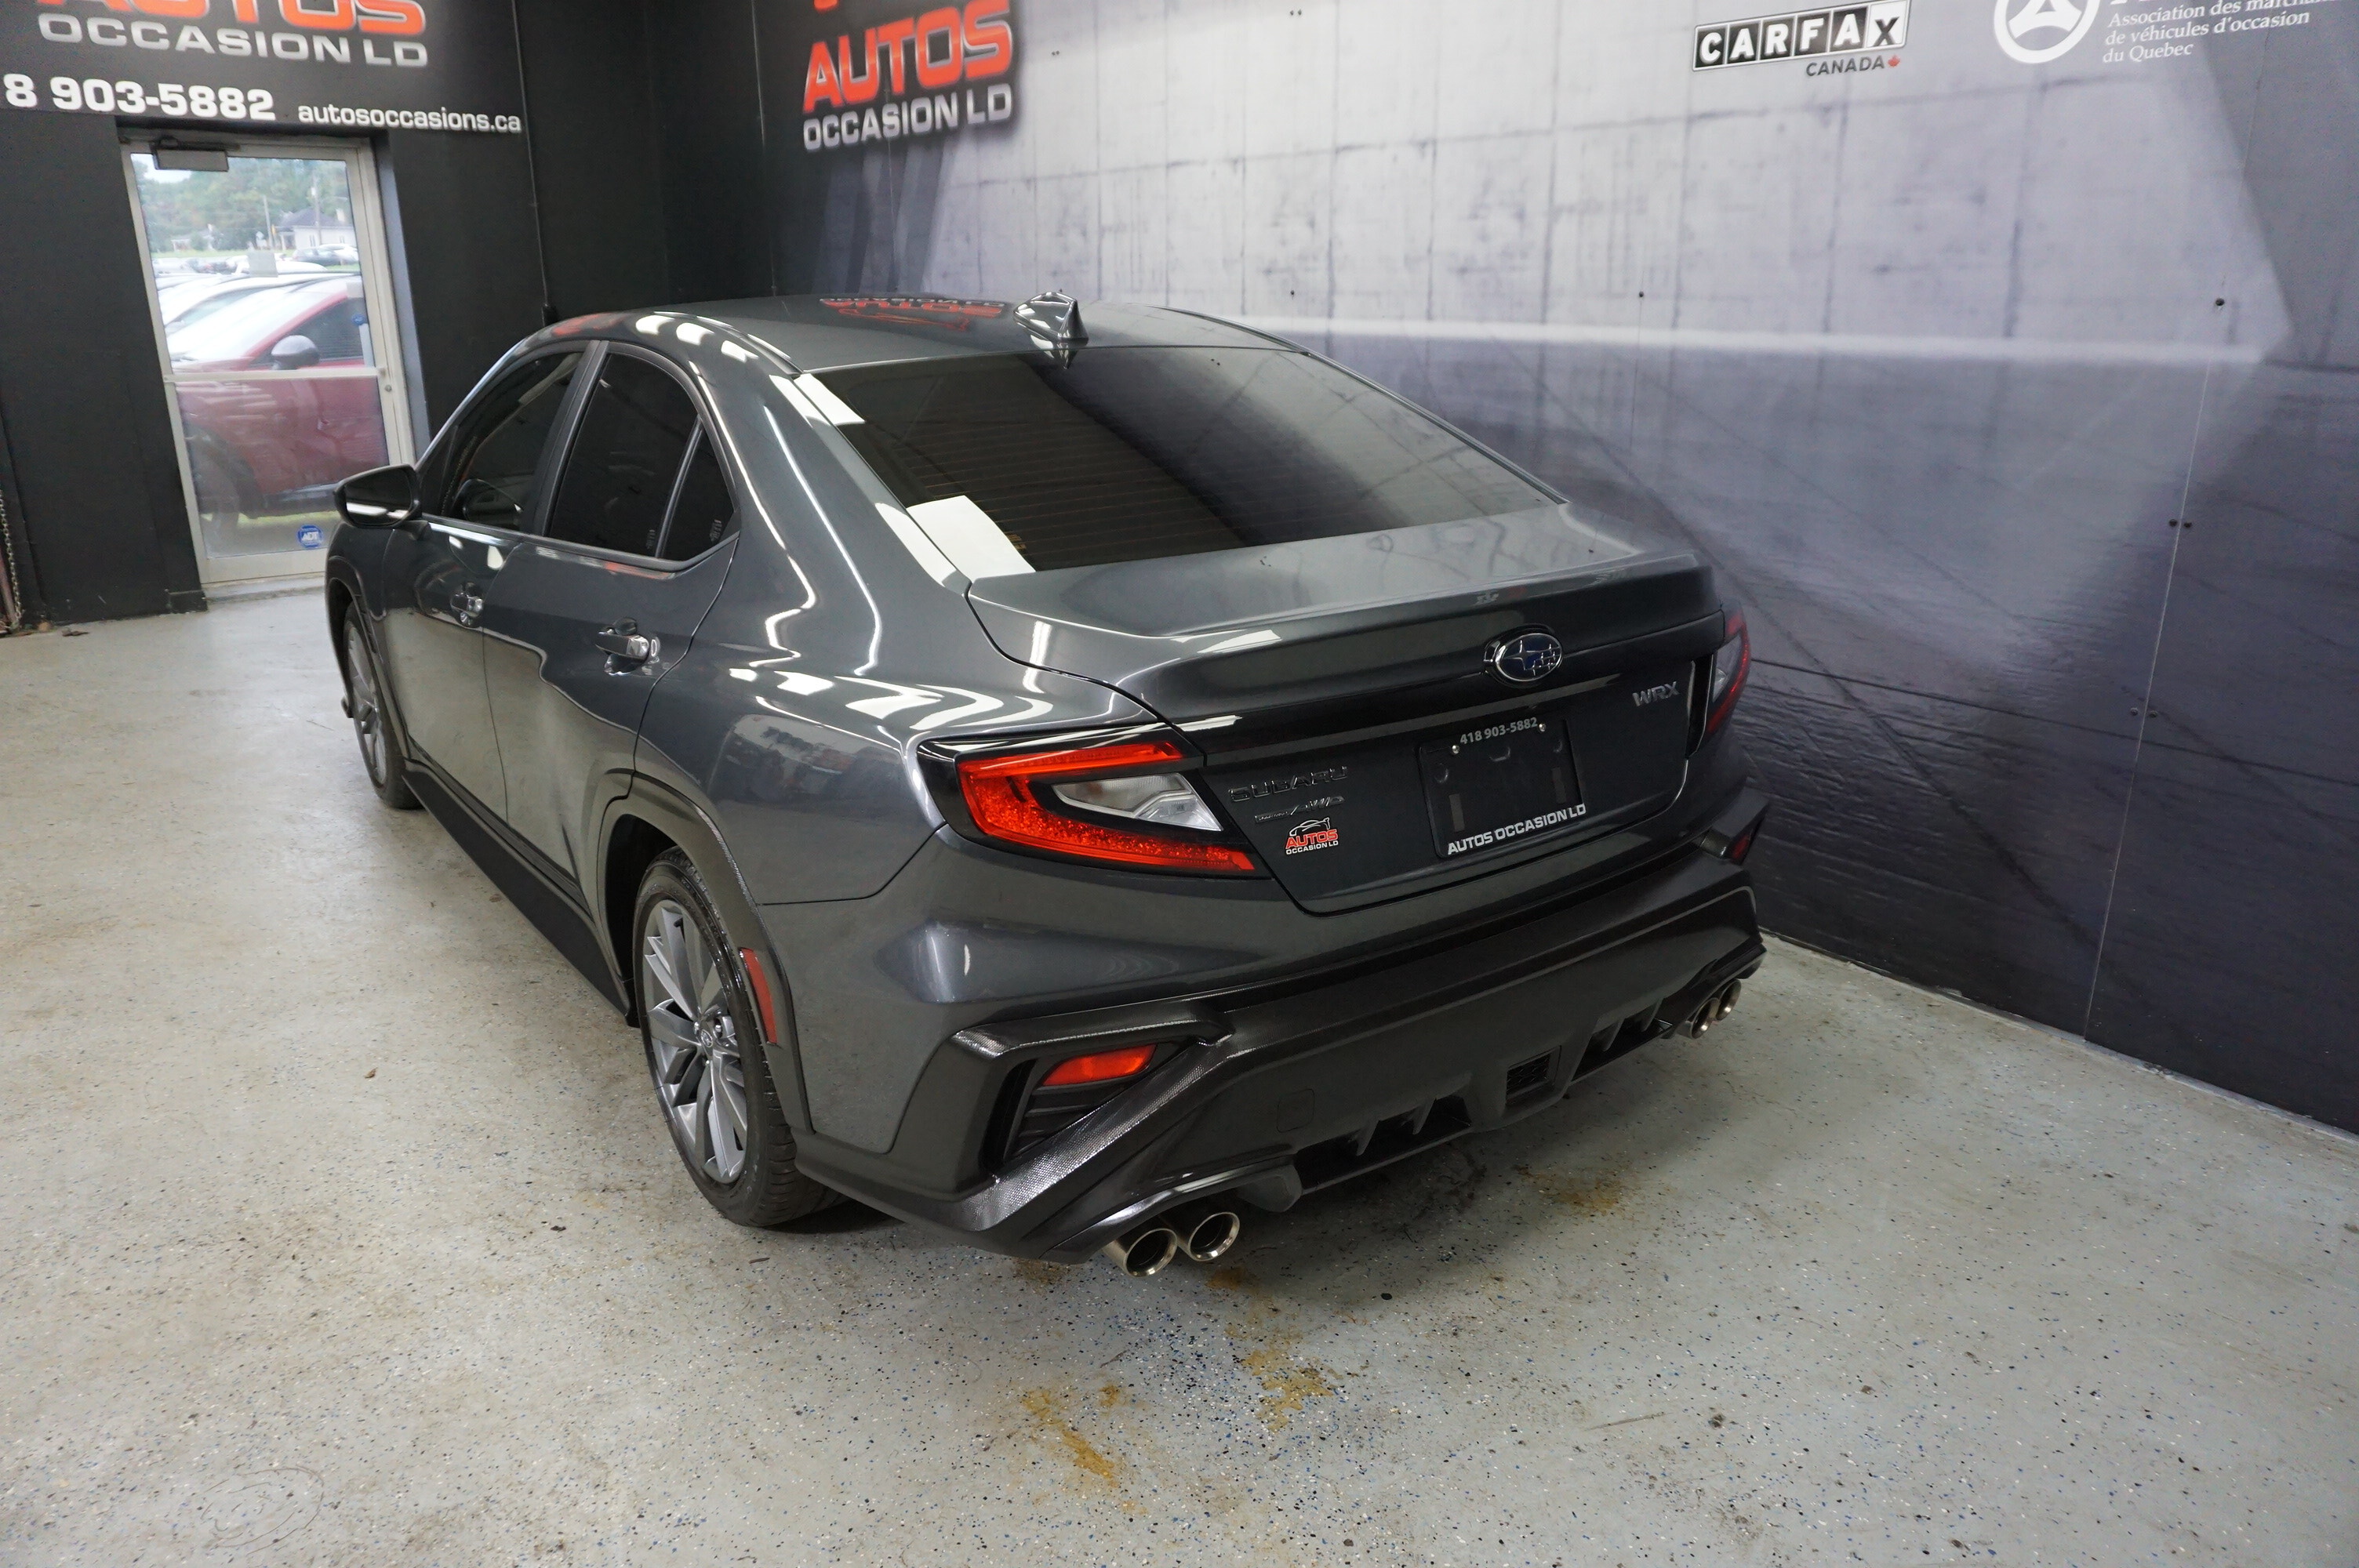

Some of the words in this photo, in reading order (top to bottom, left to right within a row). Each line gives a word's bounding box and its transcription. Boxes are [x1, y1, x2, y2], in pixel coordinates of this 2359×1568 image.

[2105, 30, 2126, 45] de
[2131, 22, 2210, 42] véhicules
[2214, 12, 2310, 34] d'occasion
[2107, 4, 2205, 27] Association
[2209, 0, 2241, 16] des
[38, 13, 351, 64] OCCASION
[362, 38, 428, 67] LD
[1699, 13, 1900, 64] CARFAX
[2103, 47, 2124, 63] du
[2129, 42, 2194, 62] Quebec
[803, 0, 1012, 113] AUTOS
[1805, 54, 1885, 77] CANADA
[49, 76, 276, 120] 903-5882
[297, 103, 522, 132] autosoccasions.ca
[803, 92, 959, 151] OCCASION
[966, 82, 1012, 125] LD
[1632, 681, 1679, 707] WRX
[1459, 730, 1482, 744] 418
[1484, 717, 1538, 739] 903-5882
[1228, 765, 1347, 802] SUBARU
[1285, 828, 1339, 849] AUTOS
[1448, 831, 1493, 855] AUTOS
[1495, 809, 1568, 841] OCCASION
[1568, 803, 1587, 818] LD
[1285, 842, 1327, 855] OCCASION
[1329, 839, 1339, 848] LD
